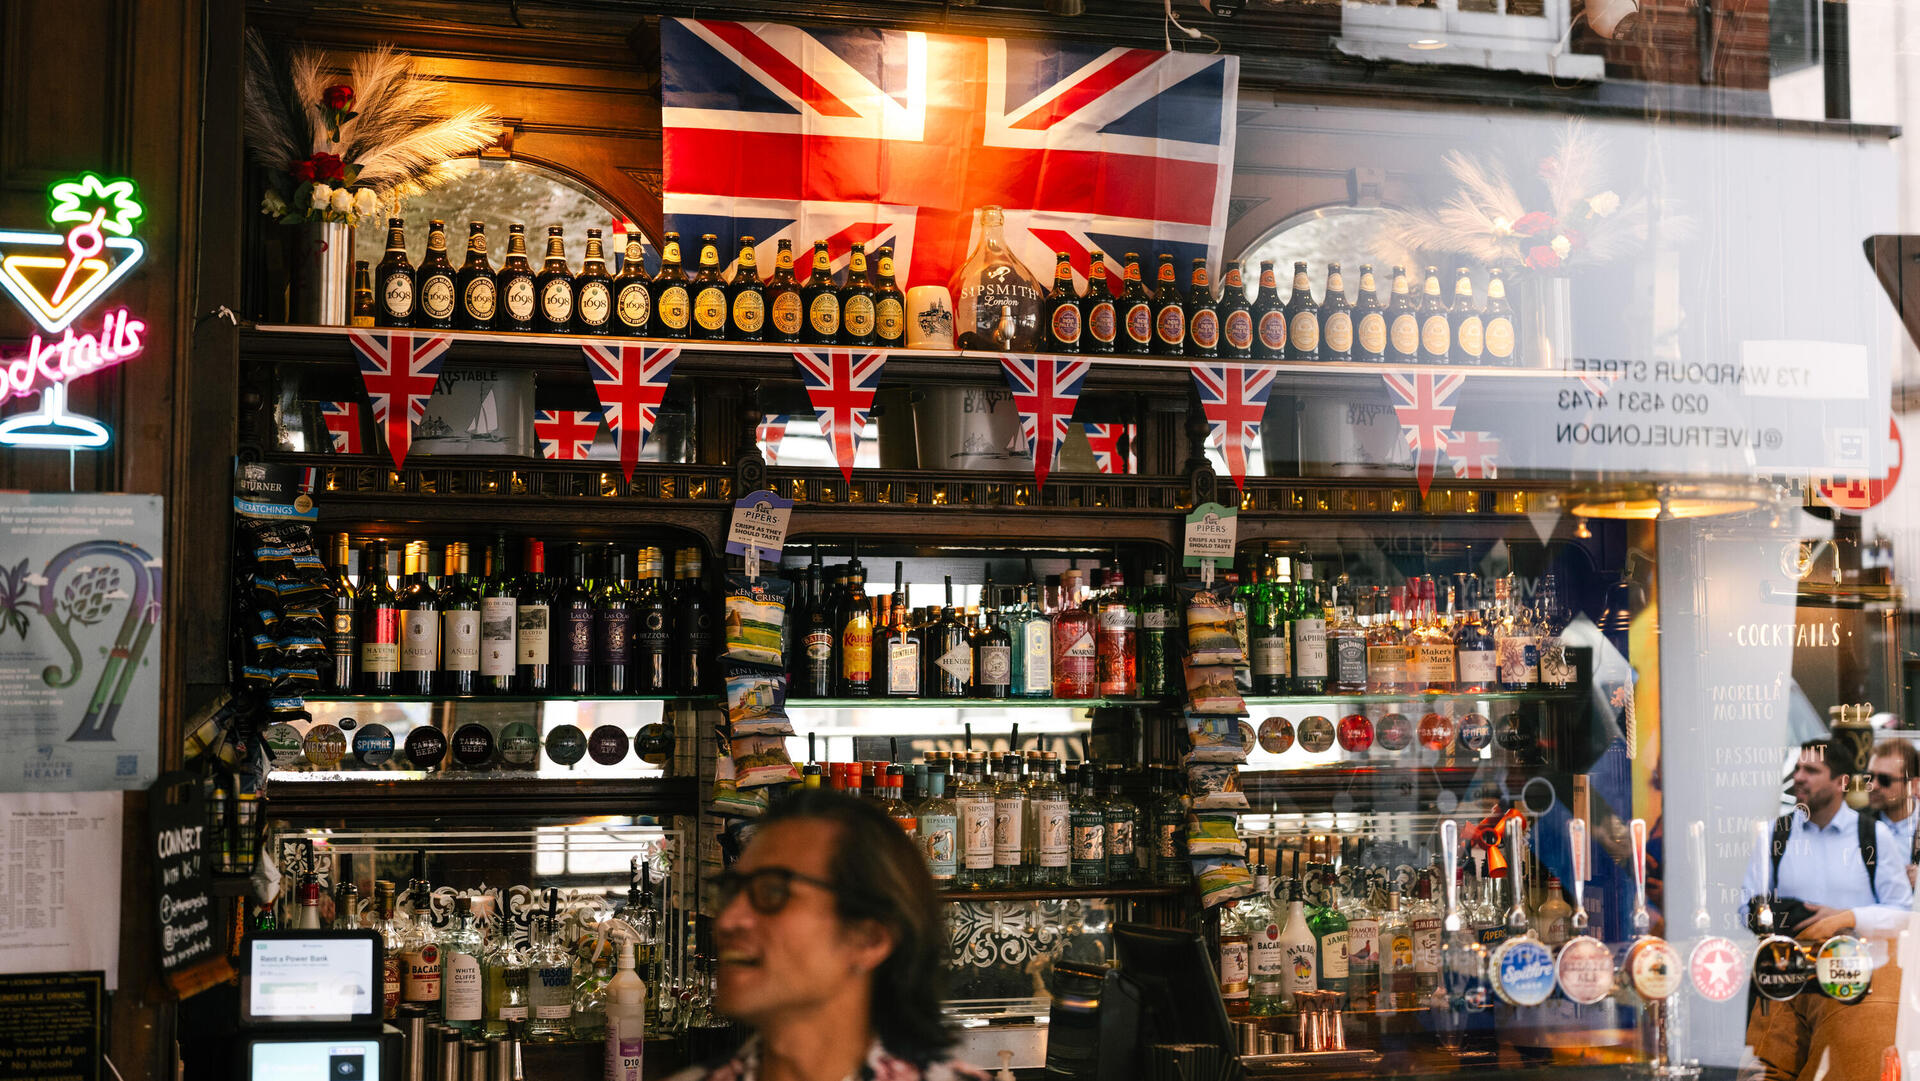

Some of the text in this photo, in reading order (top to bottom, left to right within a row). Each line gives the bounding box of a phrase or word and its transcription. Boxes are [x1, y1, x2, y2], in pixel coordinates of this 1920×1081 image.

[387, 288, 411, 302] 1698
[430, 291, 449, 303] 1698
[473, 291, 491, 304] 1698
[511, 292, 532, 305] 1698
[962, 284, 1038, 300] SIPSMITH
[547, 294, 569, 307] 1698
[584, 296, 607, 310] 1698
[626, 299, 645, 311] 1698
[984, 295, 1019, 307] London
[966, 389, 1014, 401] WHITSTA
[963, 400, 996, 414] BAY
[1349, 402, 1397, 416] WHITSTA
[1346, 411, 1376, 427] BAY
[745, 510, 777, 524] PIPERS
[735, 522, 756, 531] CRISPS
[766, 528, 782, 536] THEY
[735, 528, 760, 538] SHOULD
[761, 533, 780, 542] TASTE
[1196, 524, 1226, 534] PIPERS
[734, 587, 754, 598] KENT
[755, 593, 785, 604] CRISPS
[1298, 634, 1326, 642] LAPHRO
[1736, 622, 1841, 647] COCKTAILS
[1314, 651, 1323, 660] 10
[1421, 648, 1452, 656] Maker's
[1712, 684, 1782, 702] MORELLA
[1713, 702, 1873, 723] MOJITO £12
[1303, 734, 1318, 743] BAY
[1715, 770, 1874, 793] MARTINI £13
[158, 825, 203, 859] CONNECT
[1716, 839, 1813, 858] MARRITA
[1257, 942, 1280, 950] BACAR
[1829, 959, 1861, 969] FIRST
[502, 969, 528, 978] ABSO
[1503, 961, 1553, 984] Spitfire
[1758, 973, 1808, 985] GUINNESS
[1829, 968, 1861, 980] DROP
[16, 1046, 47, 1057] Proof
[50, 1045, 62, 1056] of
[64, 1044, 86, 1057] Age
[12, 1059, 73, 1070] No Alcohol
[624, 1058, 640, 1068] D10
